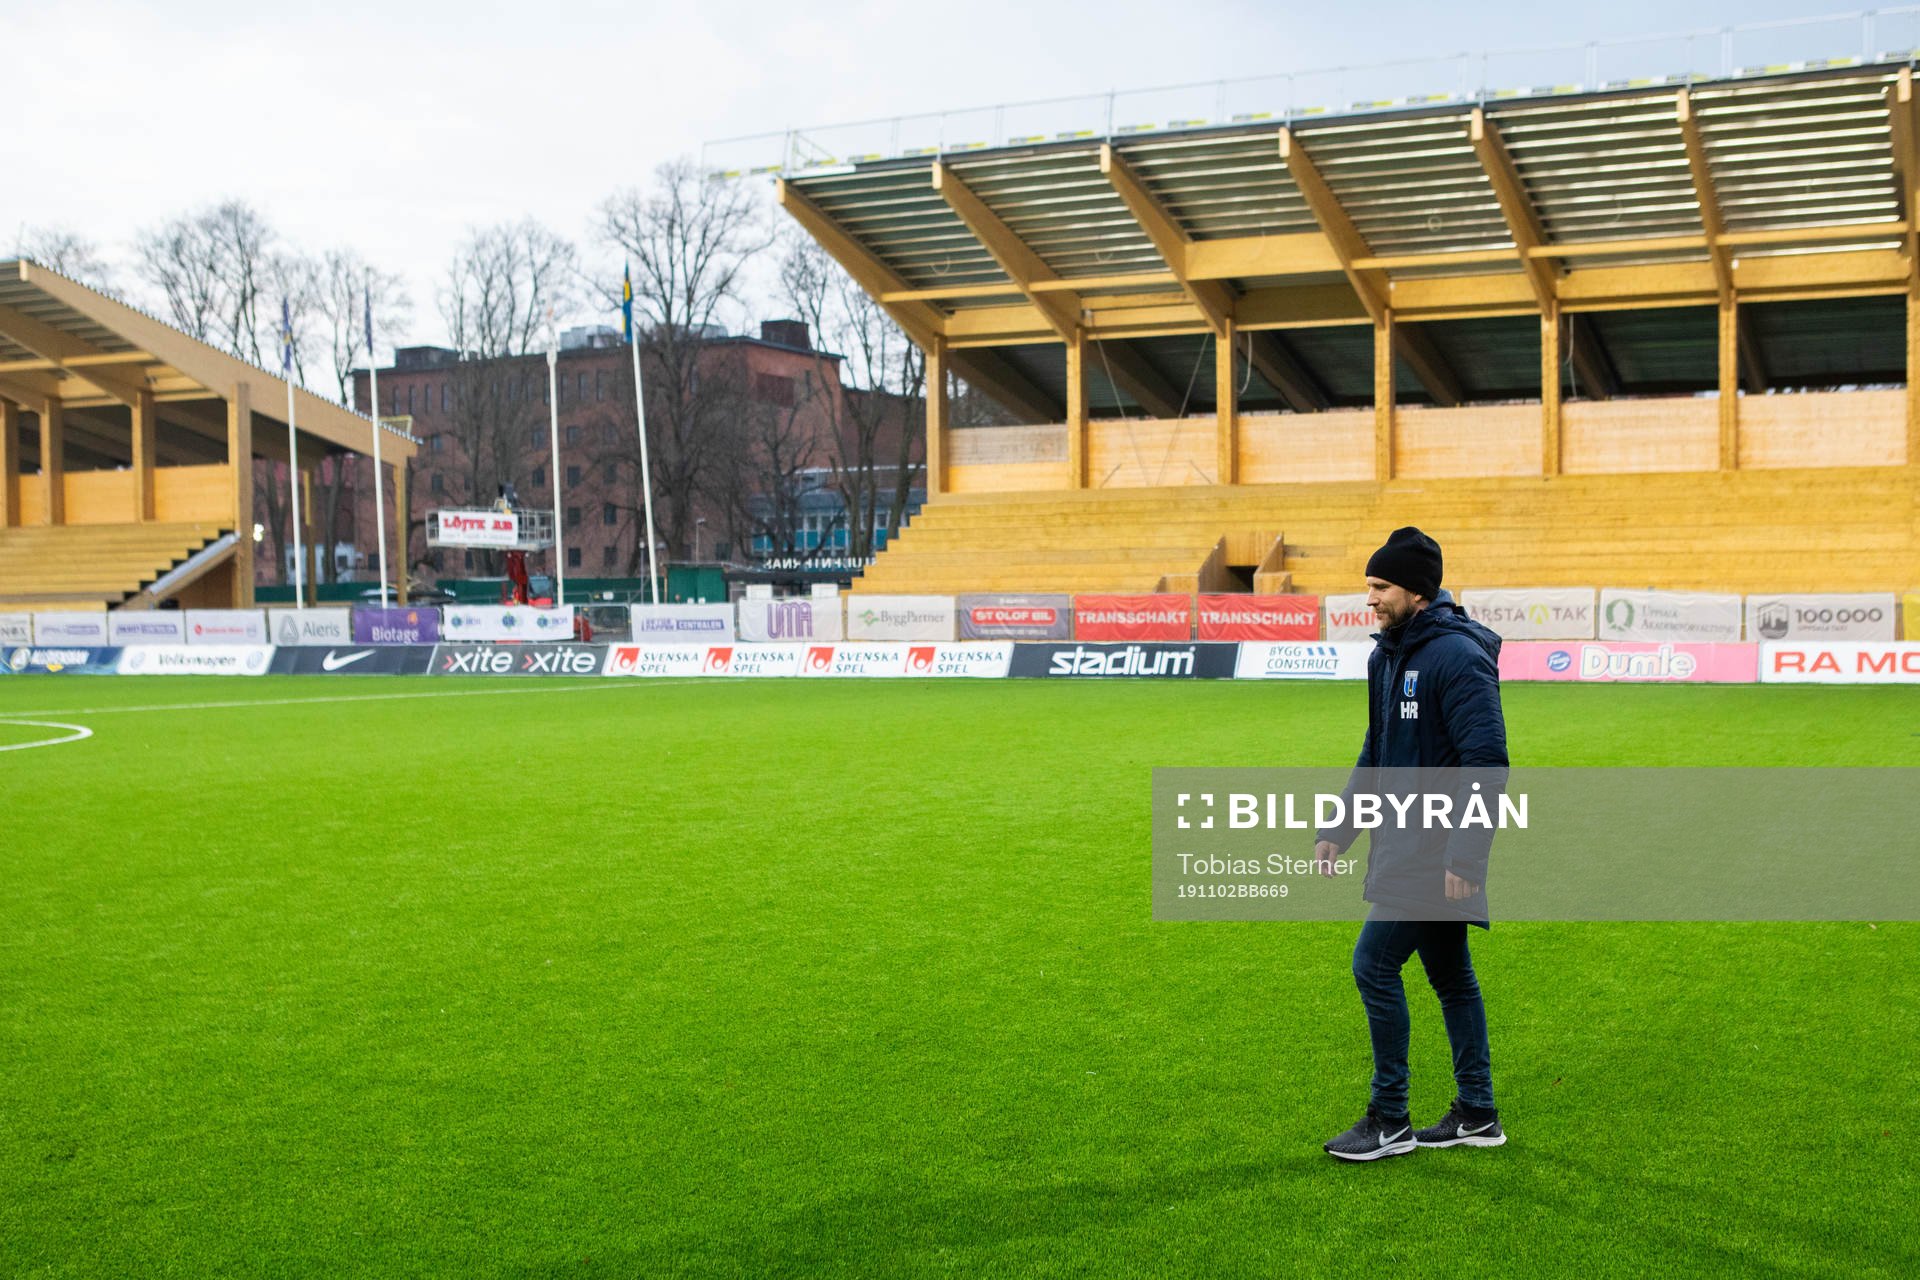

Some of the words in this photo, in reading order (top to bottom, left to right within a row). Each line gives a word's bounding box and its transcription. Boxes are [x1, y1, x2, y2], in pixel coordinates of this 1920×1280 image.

[880, 610, 944, 627] ByggPartner
[995, 611, 1029, 621] OLOF
[1077, 611, 1188, 624] TRANSSCHAKT
[1201, 611, 1316, 625] TRANSSCHAKT
[1552, 606, 1587, 620] TAK
[767, 602, 812, 639] UMA
[303, 621, 341, 637] Aleris
[372, 626, 419, 645] Biotage
[643, 652, 699, 662] SVENSKA
[736, 652, 794, 662] SVENSKA
[839, 652, 899, 662] SVENSKA
[941, 652, 1003, 662] SVENSKA
[1269, 646, 1302, 656] BYGG
[449, 646, 514, 673] xite
[528, 646, 597, 673] xite
[1049, 646, 1196, 675] stadium
[1267, 658, 1339, 670] CONSTRUCT
[1582, 645, 1694, 677] Dumle
[1774, 652, 1841, 673] RA
[640, 664, 667, 673] SPEL
[733, 664, 761, 673] SPEL
[836, 664, 865, 673] SPEL
[938, 664, 968, 673] SPEL
[1401, 701, 1419, 719] HR
